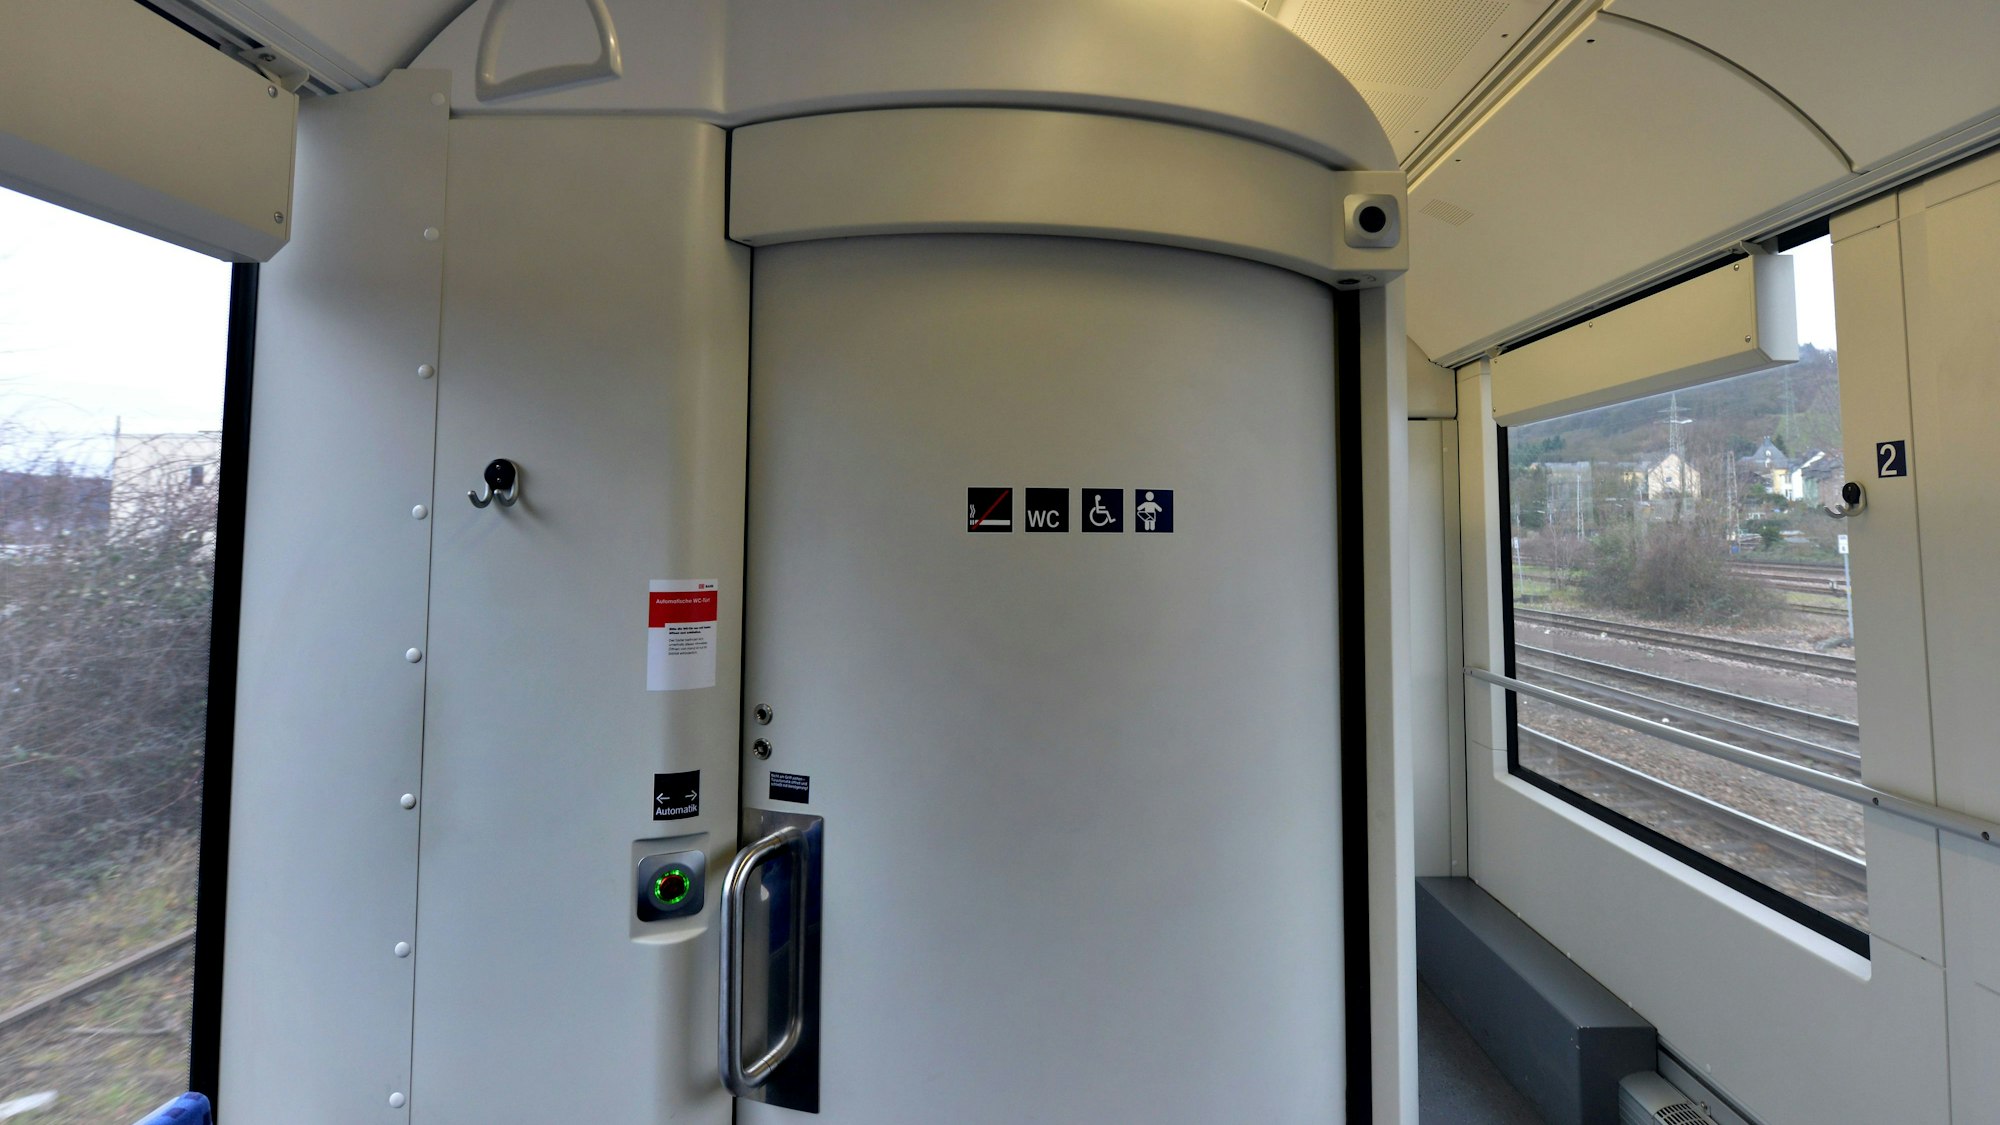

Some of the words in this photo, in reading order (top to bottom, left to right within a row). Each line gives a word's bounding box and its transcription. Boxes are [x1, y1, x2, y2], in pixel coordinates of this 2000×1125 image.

[1880, 444, 1897, 476] 2
[1027, 510, 1060, 528] WC
[656, 804, 697, 815] Automatik
